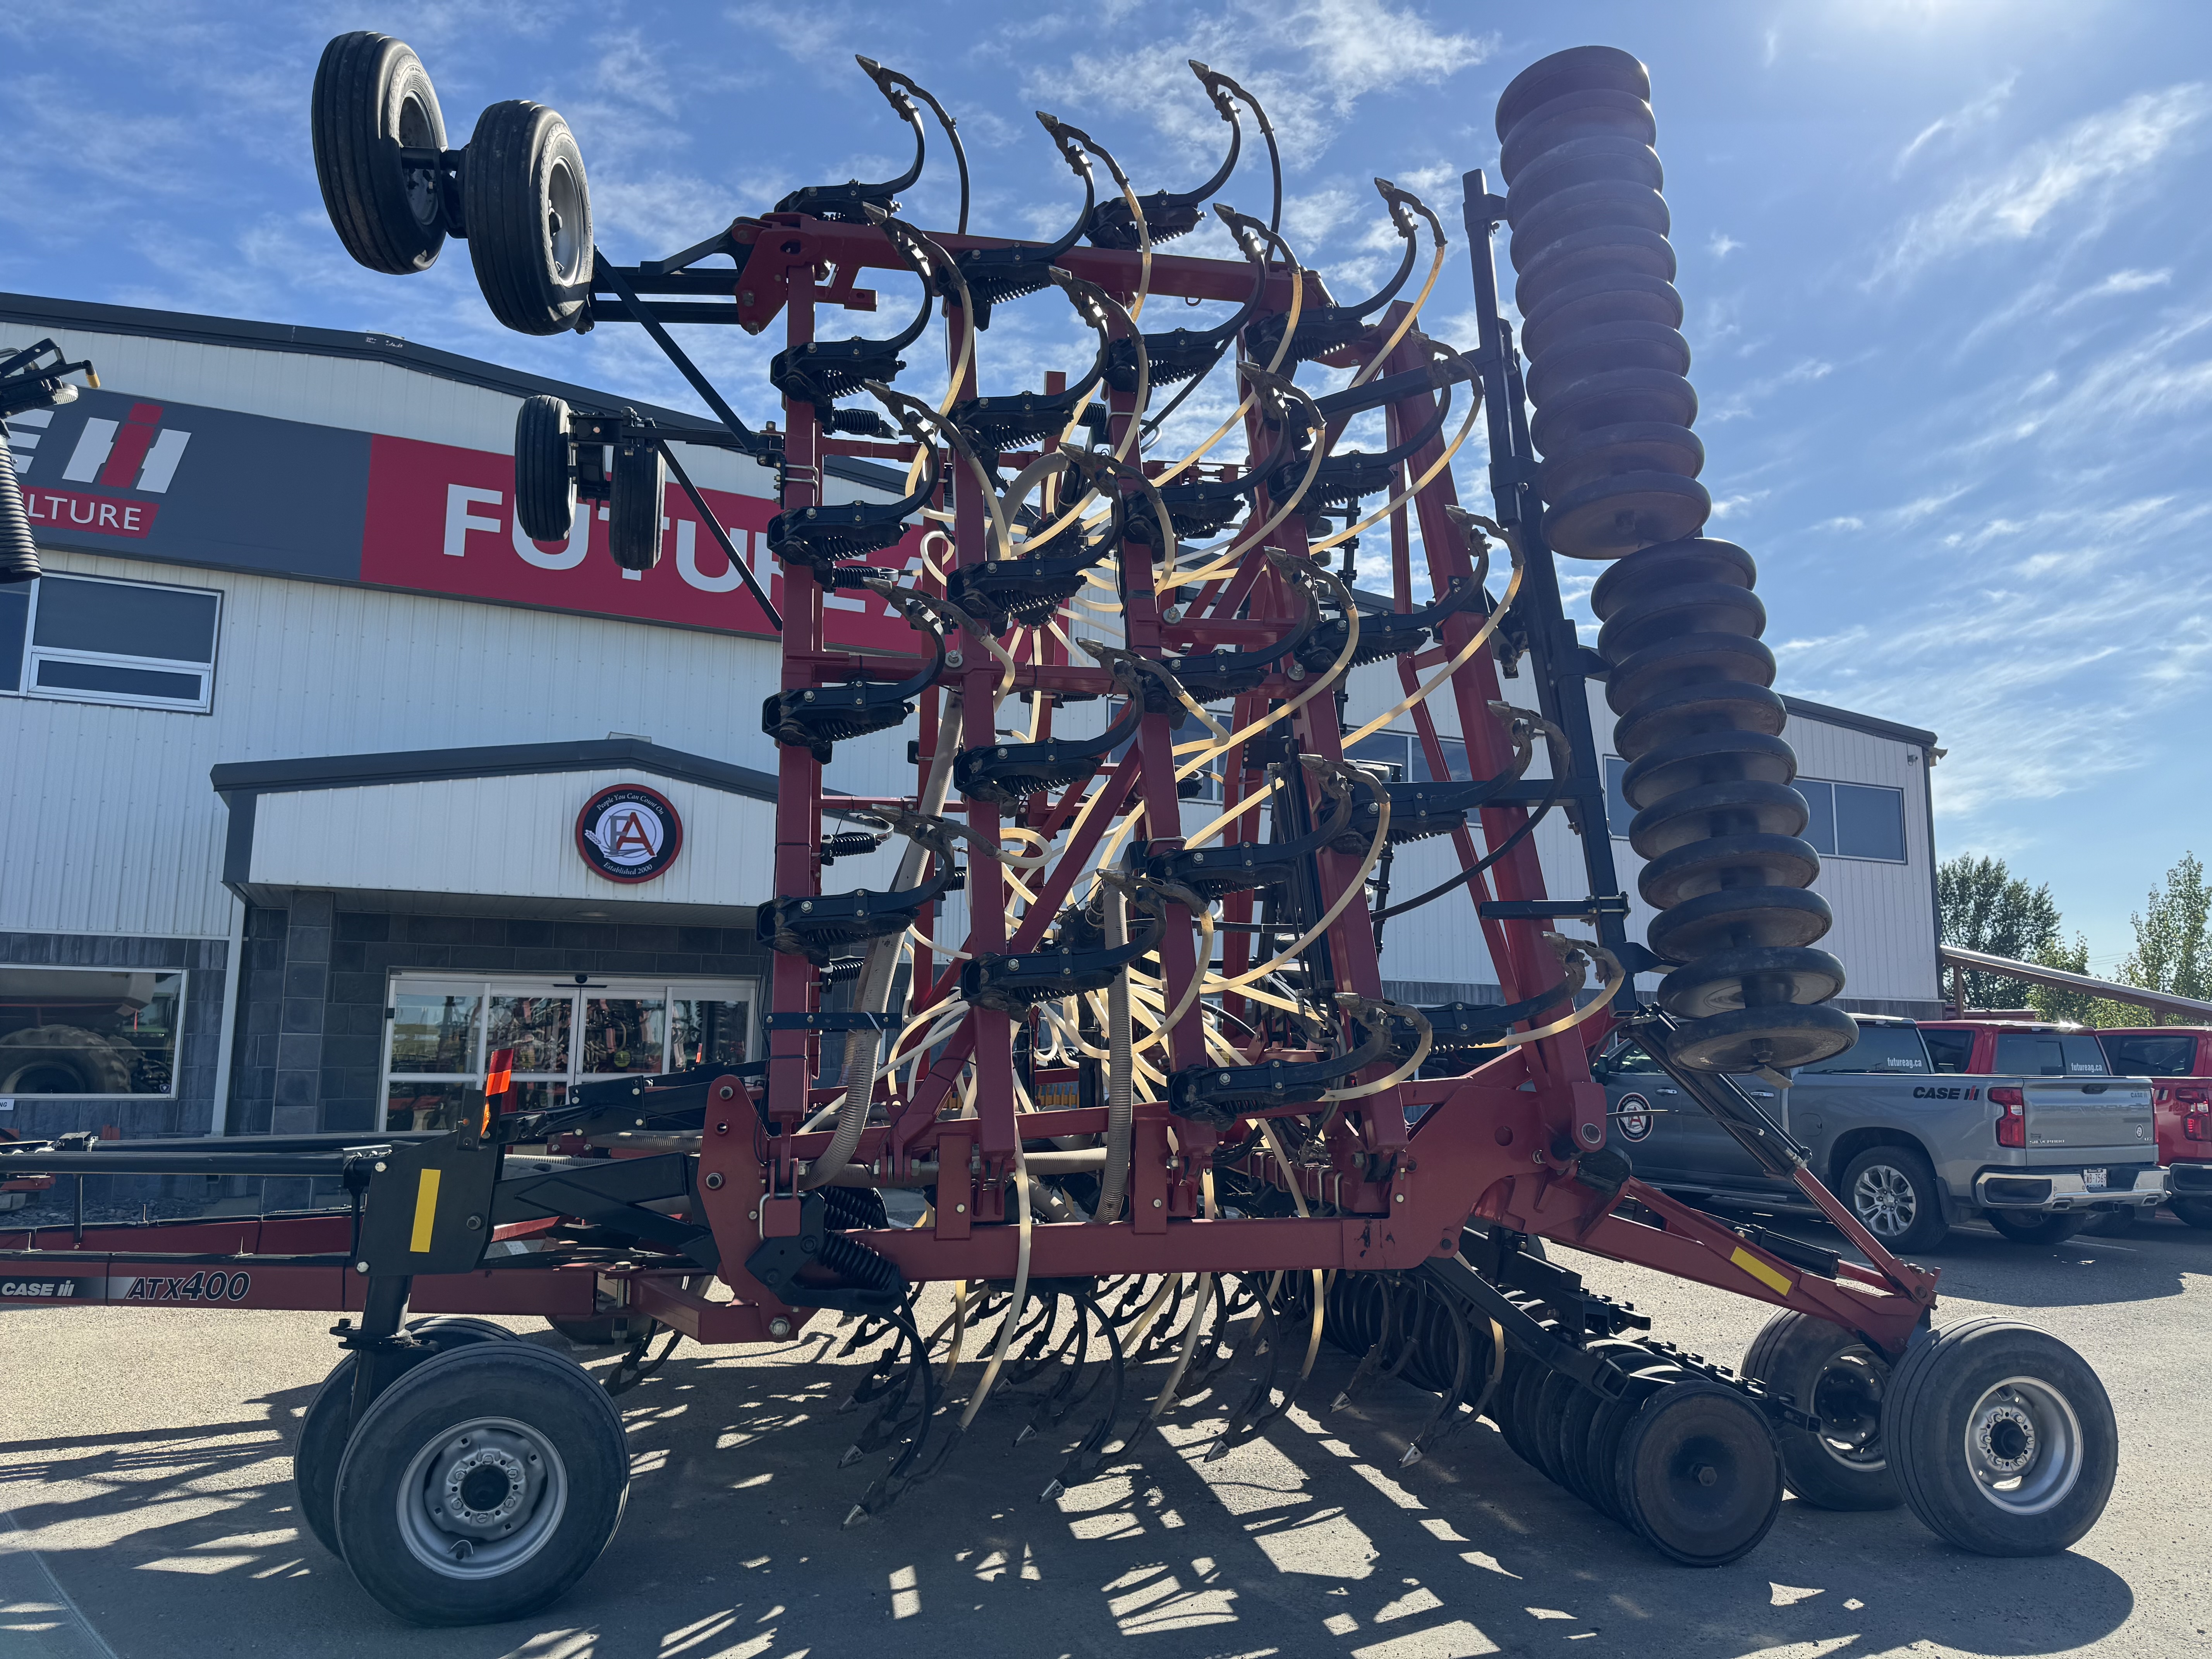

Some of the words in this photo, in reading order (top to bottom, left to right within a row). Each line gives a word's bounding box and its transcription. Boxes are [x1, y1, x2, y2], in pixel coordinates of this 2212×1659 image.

[597, 797, 614, 811] People
[640, 796, 657, 807] Count
[656, 806, 664, 814] On
[603, 862, 637, 875] Established
[638, 864, 653, 874] 2000
[1887, 1058, 1922, 1068] futureag.ca
[2071, 1063, 2102, 1073] futureag.ca
[1913, 1087, 1961, 1100] CASE
[2, 1283, 55, 1296] CASE
[127, 1271, 251, 1301] ATX400
